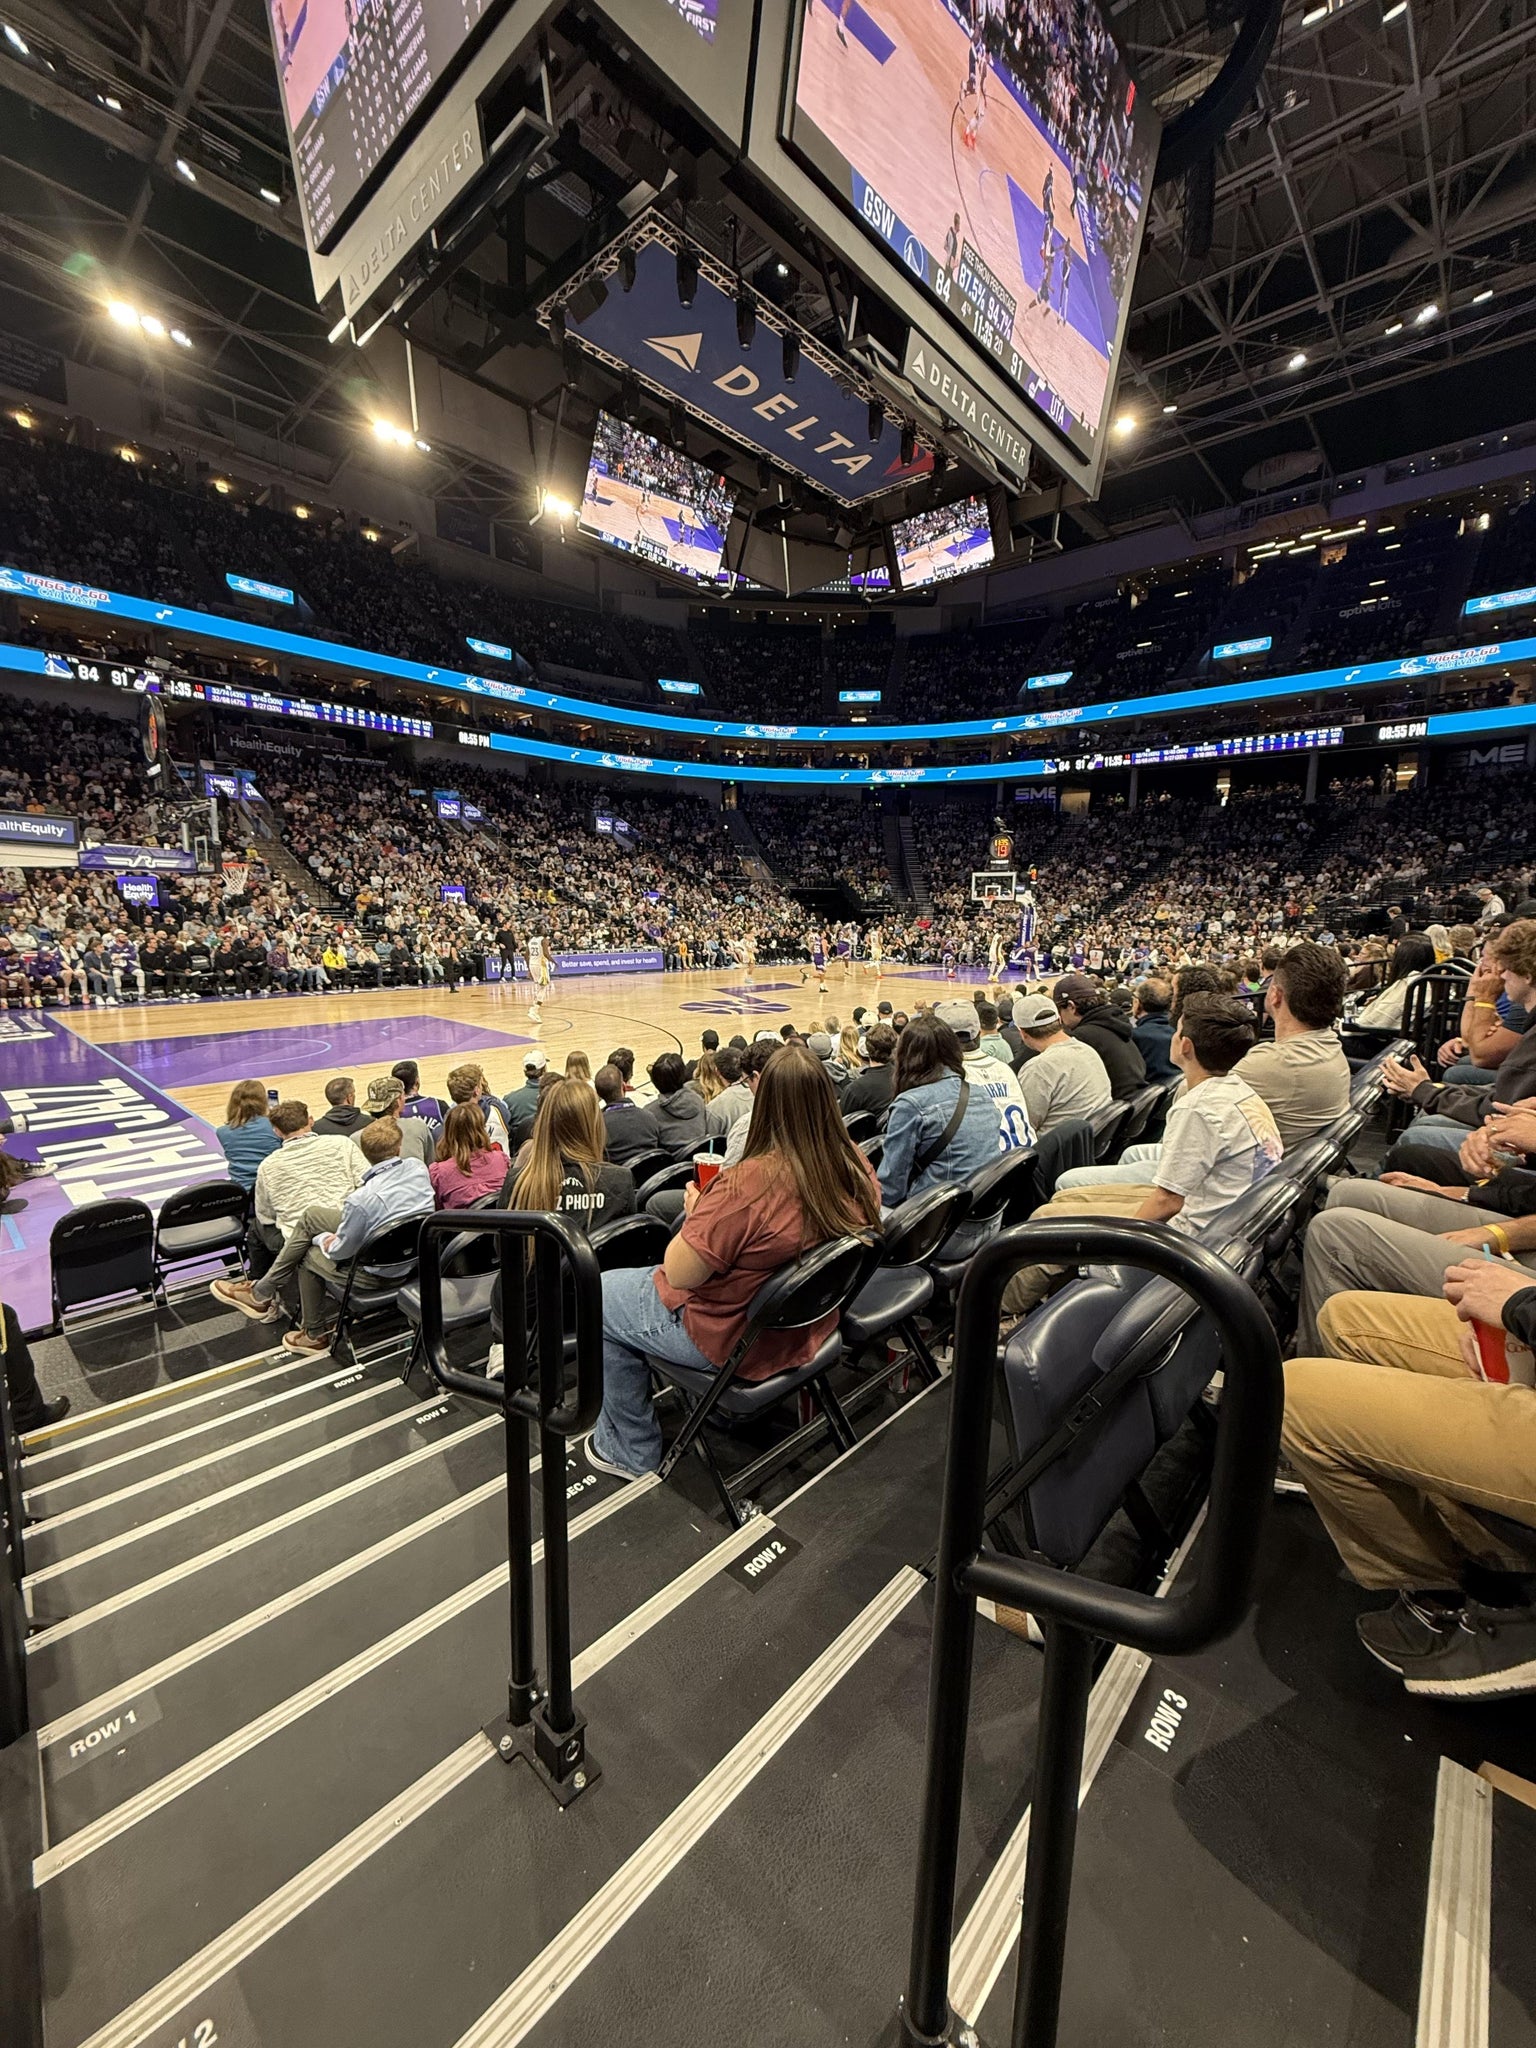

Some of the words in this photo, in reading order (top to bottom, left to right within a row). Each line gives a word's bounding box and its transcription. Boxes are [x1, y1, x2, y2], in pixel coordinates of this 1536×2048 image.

[686, 11, 716, 33] FIRST
[360, 215, 407, 288] DELTA
[409, 129, 474, 222] CENTER
[963, 242, 976, 267] FREE
[974, 258, 993, 286] THROW
[989, 277, 1016, 316] PERCENTAGE
[863, 185, 896, 240] GSW
[935, 267, 951, 303] 84
[973, 310, 994, 349] 11:35
[993, 336, 1004, 356] 20
[1010, 352, 1023, 381] 91
[1050, 394, 1065, 426] UTA
[959, 263, 986, 311] 87.5%
[987, 296, 1013, 341] 94.7%
[712, 364, 874, 476] DELTA
[929, 362, 977, 423] DELTA
[980, 412, 1027, 468] CENTER
[64, 592, 98, 608] WASH
[78, 664, 100, 682] 84
[110, 669, 128, 687] 91
[458, 731, 478, 746] 08:55
[479, 735, 490, 748] PM
[1378, 724, 1408, 741] 08:55
[1409, 722, 1427, 738] PM
[229, 736, 302, 758] HealthEquity
[1058, 760, 1071, 772] 84
[1015, 785, 1057, 800] SME
[0, 820, 64, 838] althEquity
[561, 960, 579, 968] Better
[611, 958, 621, 966] and
[621, 958, 635, 966] invest
[202, 1195, 243, 1208] entrata
[565, 1192, 605, 1210] PHOTO
[98, 1212, 146, 1229] entrata
[273, 1351, 293, 1361] ROW
[333, 1377, 356, 1389] ROW
[356, 1373, 364, 1381] D
[416, 1410, 440, 1425] ROW
[440, 1406, 449, 1414] E
[743, 1546, 777, 1577] ROW
[771, 1541, 787, 1555] 2
[1144, 1700, 1182, 1753] ROW
[1163, 1688, 1188, 1710] 3
[69, 1717, 122, 1758] ROW
[124, 1709, 138, 1724] 1
[193, 2018, 219, 2047] 2
